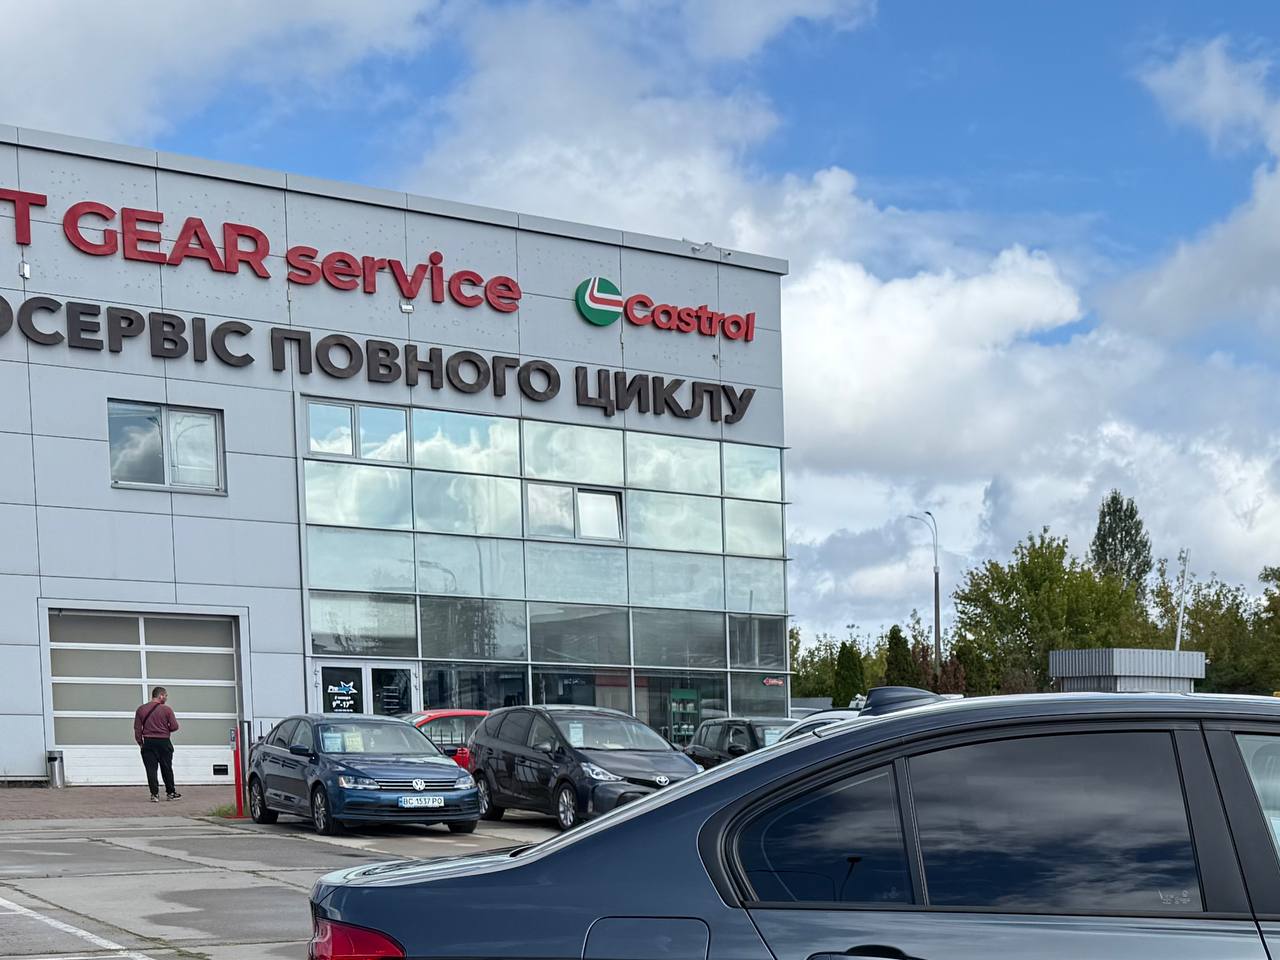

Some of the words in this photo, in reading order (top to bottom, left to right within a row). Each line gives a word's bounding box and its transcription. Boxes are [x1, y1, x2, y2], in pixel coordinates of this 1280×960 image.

[62, 201, 271, 279] GEAR
[286, 245, 521, 313] service
[0, 294, 255, 368] СЕРВІС
[271, 327, 561, 401] ПОВНОГО
[575, 366, 756, 424] ЦИКЛУ
[623, 294, 756, 341] Castrol
